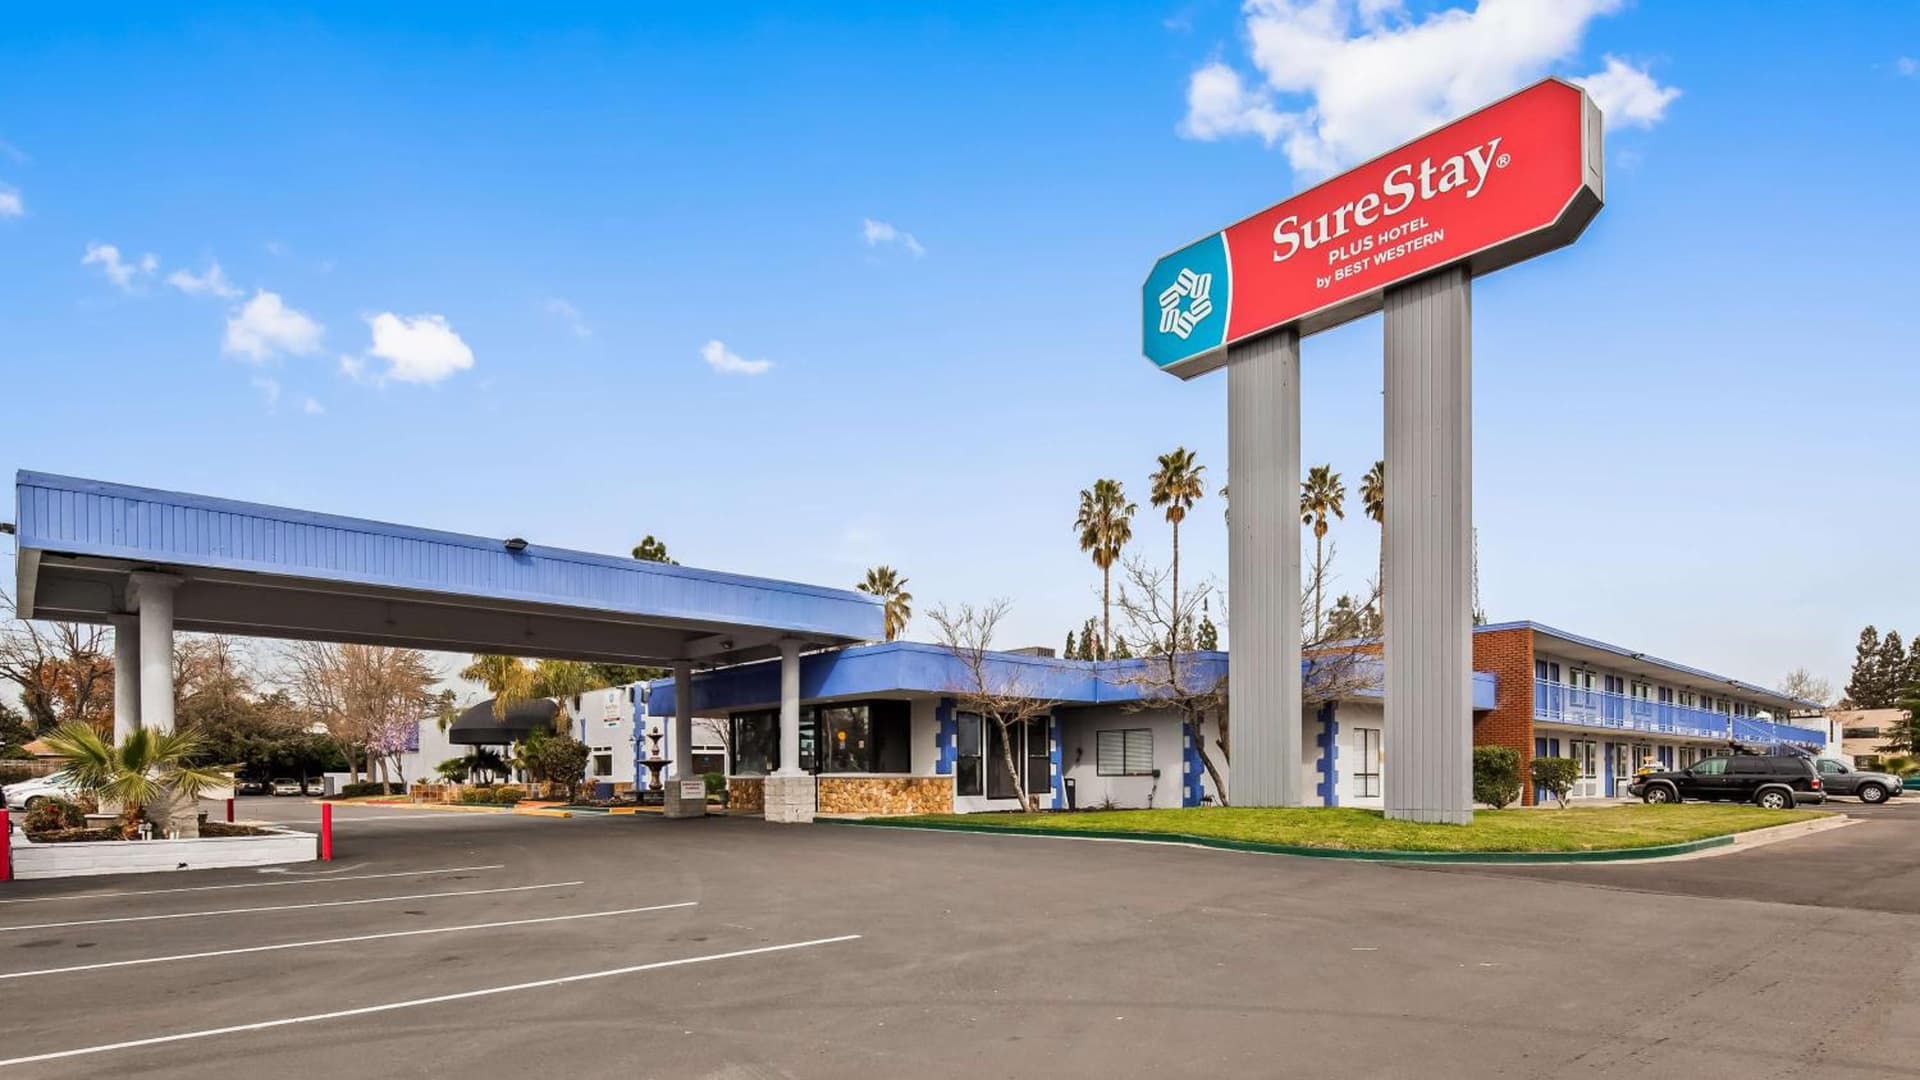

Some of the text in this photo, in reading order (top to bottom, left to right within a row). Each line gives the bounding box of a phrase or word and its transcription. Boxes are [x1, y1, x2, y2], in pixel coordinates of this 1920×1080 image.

[1316, 229, 1445, 288] by BEST WESTERN
[1328, 216, 1429, 265] PLUS HOTEL
